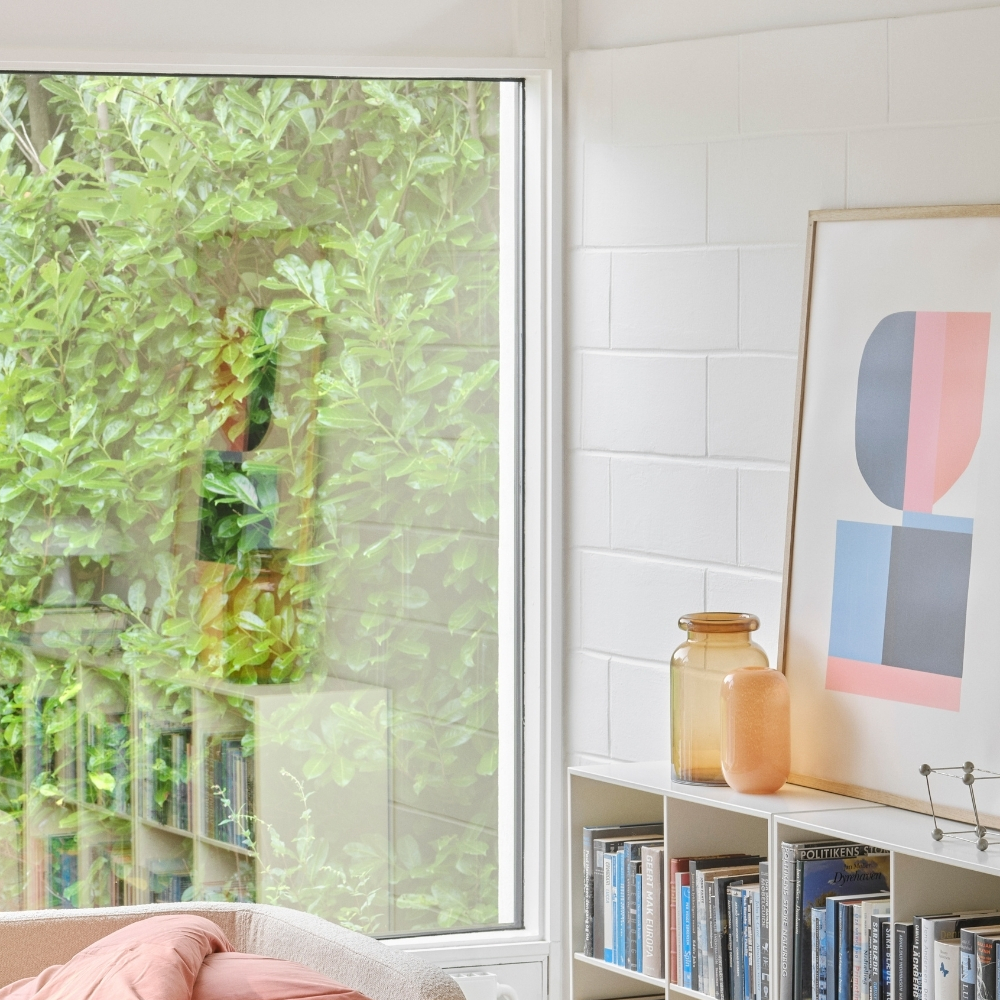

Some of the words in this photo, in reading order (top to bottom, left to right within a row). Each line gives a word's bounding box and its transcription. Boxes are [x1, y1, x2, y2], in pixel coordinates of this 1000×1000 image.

[800, 846, 860, 861] POLITIKENS
[646, 854, 654, 888] GEERT
[833, 871, 882, 887] Dyrehaven
[646, 890, 654, 916] MAK
[646, 918, 654, 958] EUROPA
[912, 945, 921, 998] LÄCKBERG
